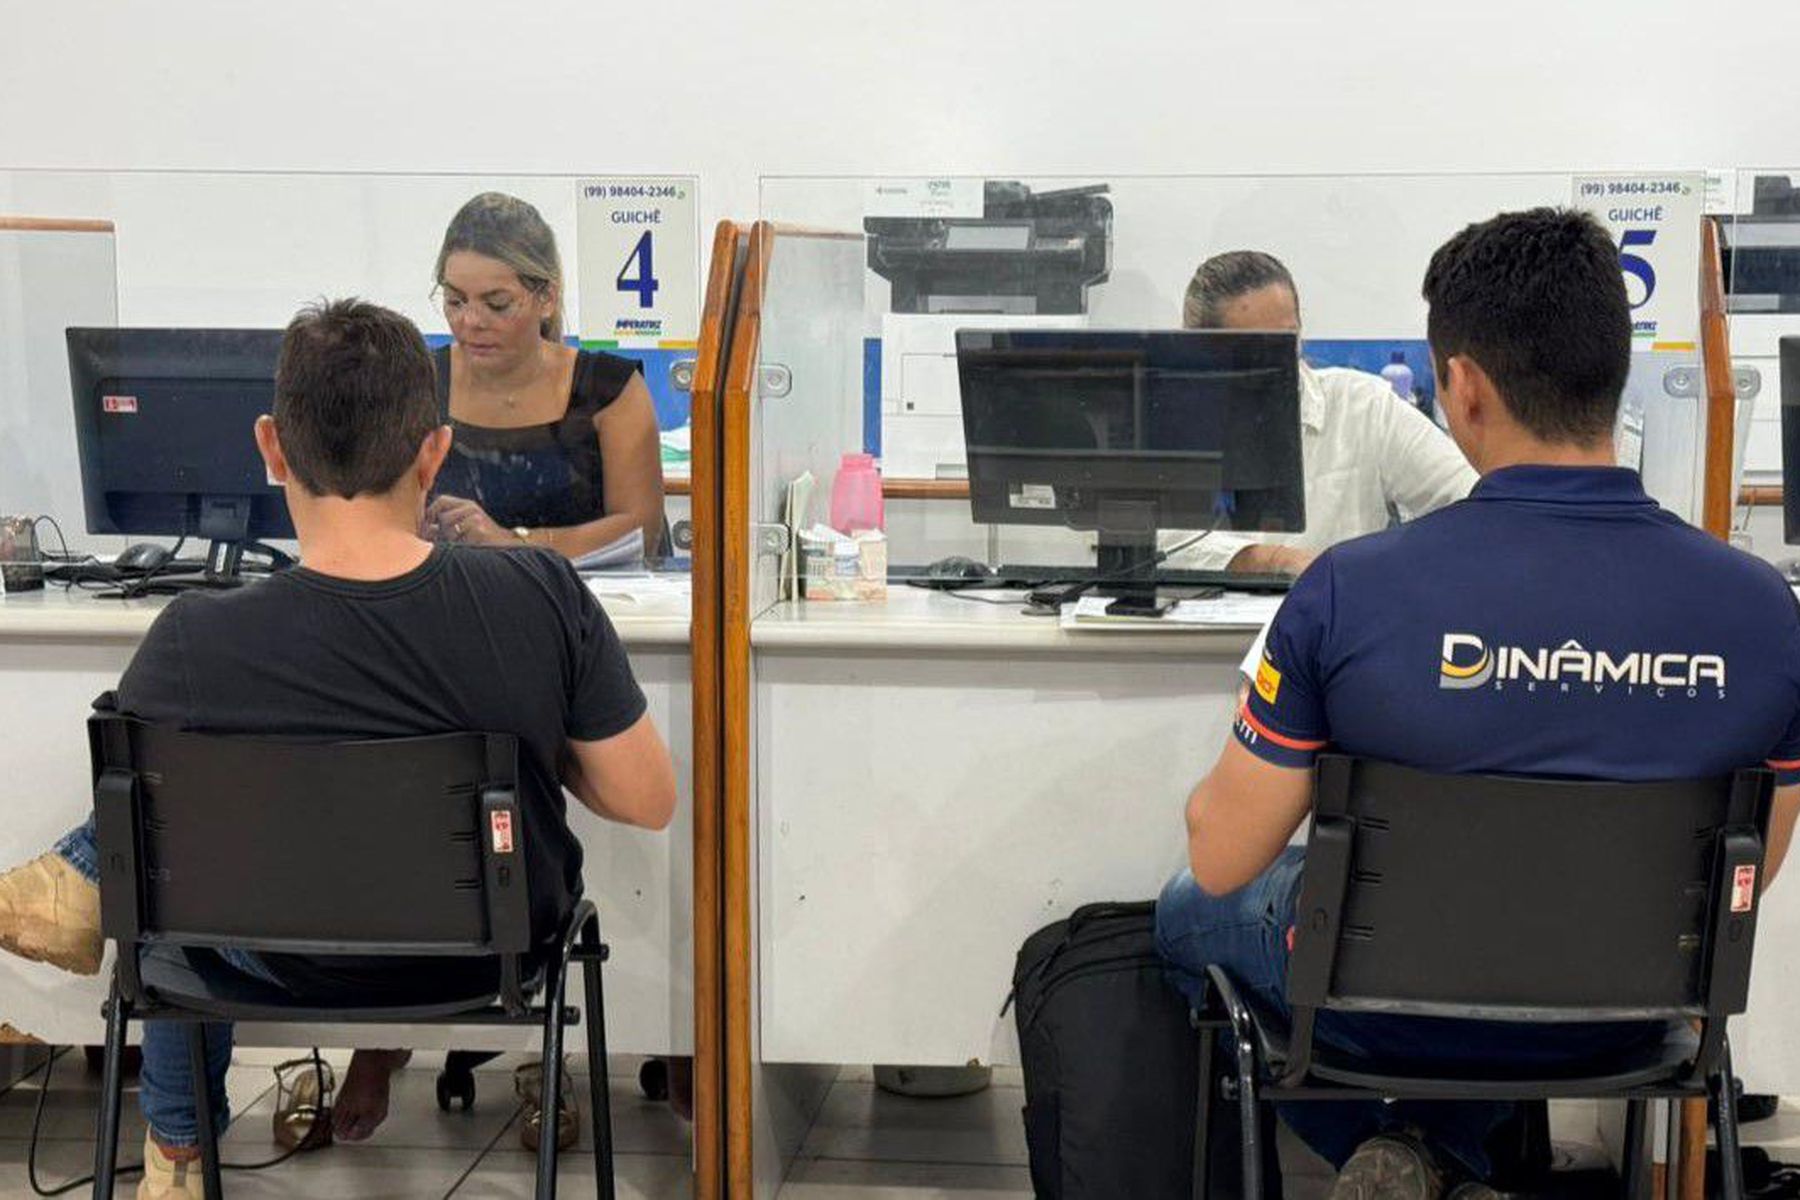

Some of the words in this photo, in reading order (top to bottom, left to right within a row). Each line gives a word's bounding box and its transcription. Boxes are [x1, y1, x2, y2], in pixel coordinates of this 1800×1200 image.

[584, 186, 606, 199] (99)
[610, 187, 676, 198] 98404-2346
[1581, 182, 1604, 196] (99)
[1608, 183, 1681, 194] 98404-2346
[611, 208, 661, 223] GUICHÊ
[1608, 206, 1663, 221] GUICHÊ
[617, 229, 659, 308] 4
[1619, 229, 1657, 309] 5
[1440, 633, 1725, 688] DINÂMICA
[1495, 680, 1726, 699] SERVIÇOS
